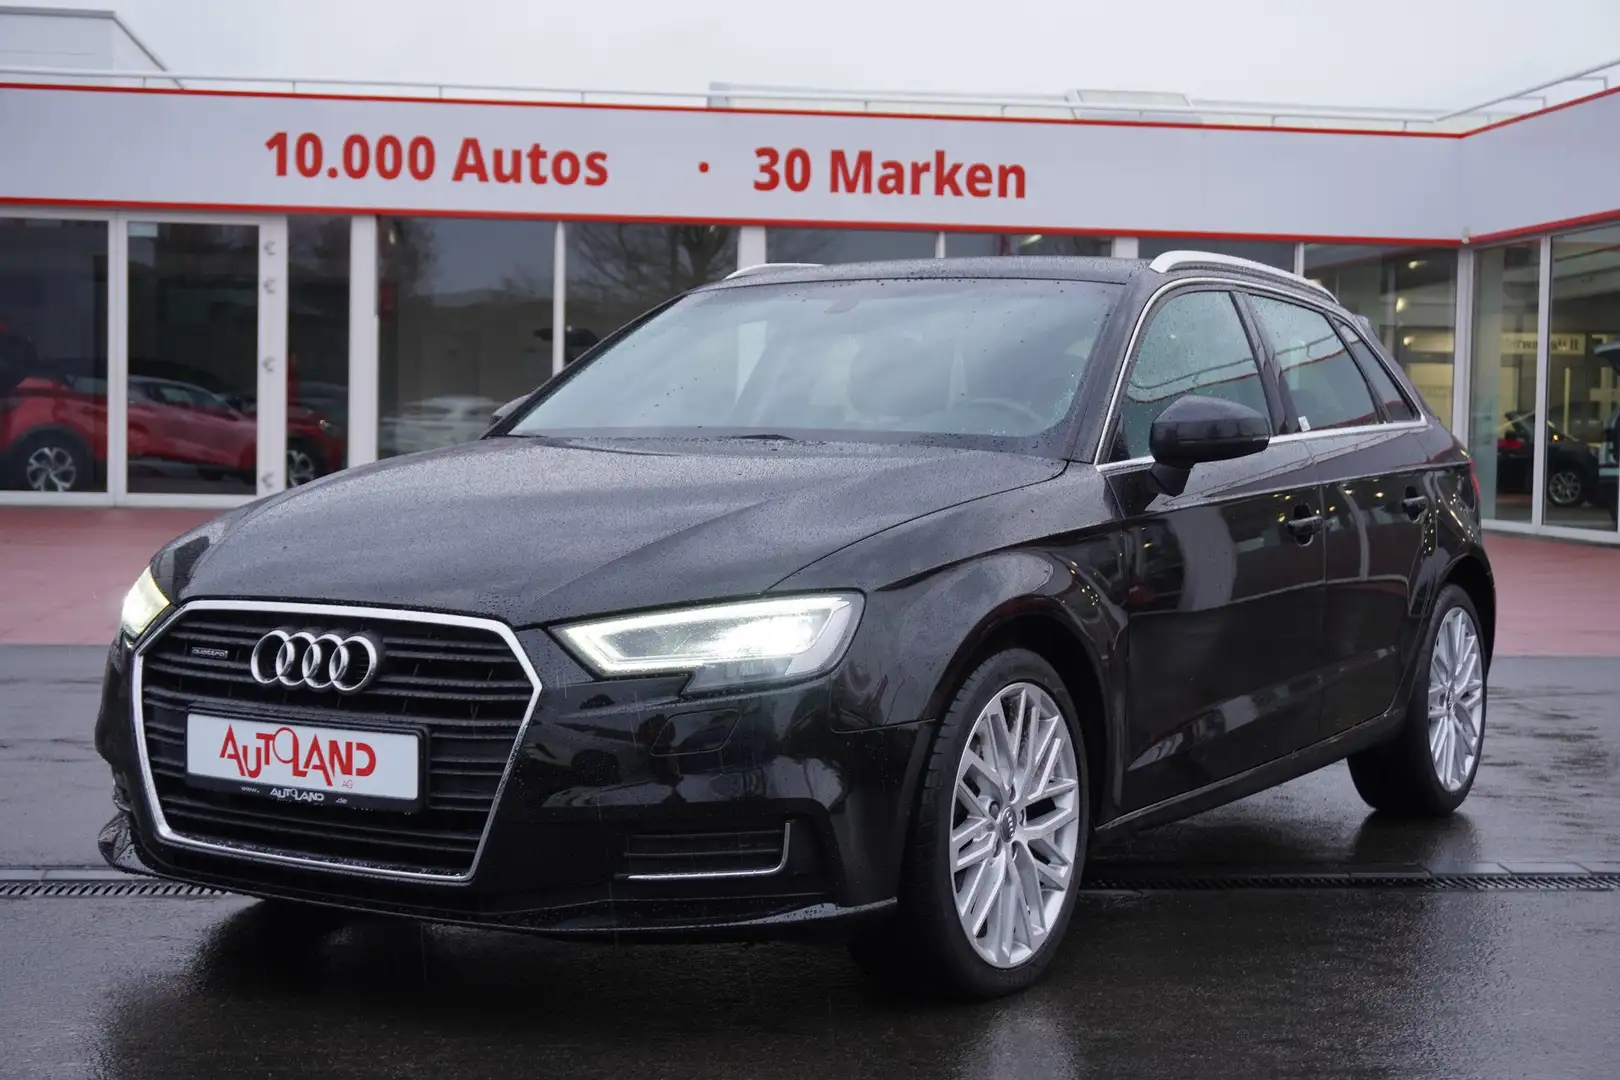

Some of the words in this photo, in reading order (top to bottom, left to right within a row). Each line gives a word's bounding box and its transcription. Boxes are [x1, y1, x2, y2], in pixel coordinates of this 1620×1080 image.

[265, 132, 435, 181] 10.000
[451, 137, 608, 186] Autos
[753, 147, 811, 193] 30
[830, 149, 1026, 199] Marken
[341, 780, 353, 789] AG
